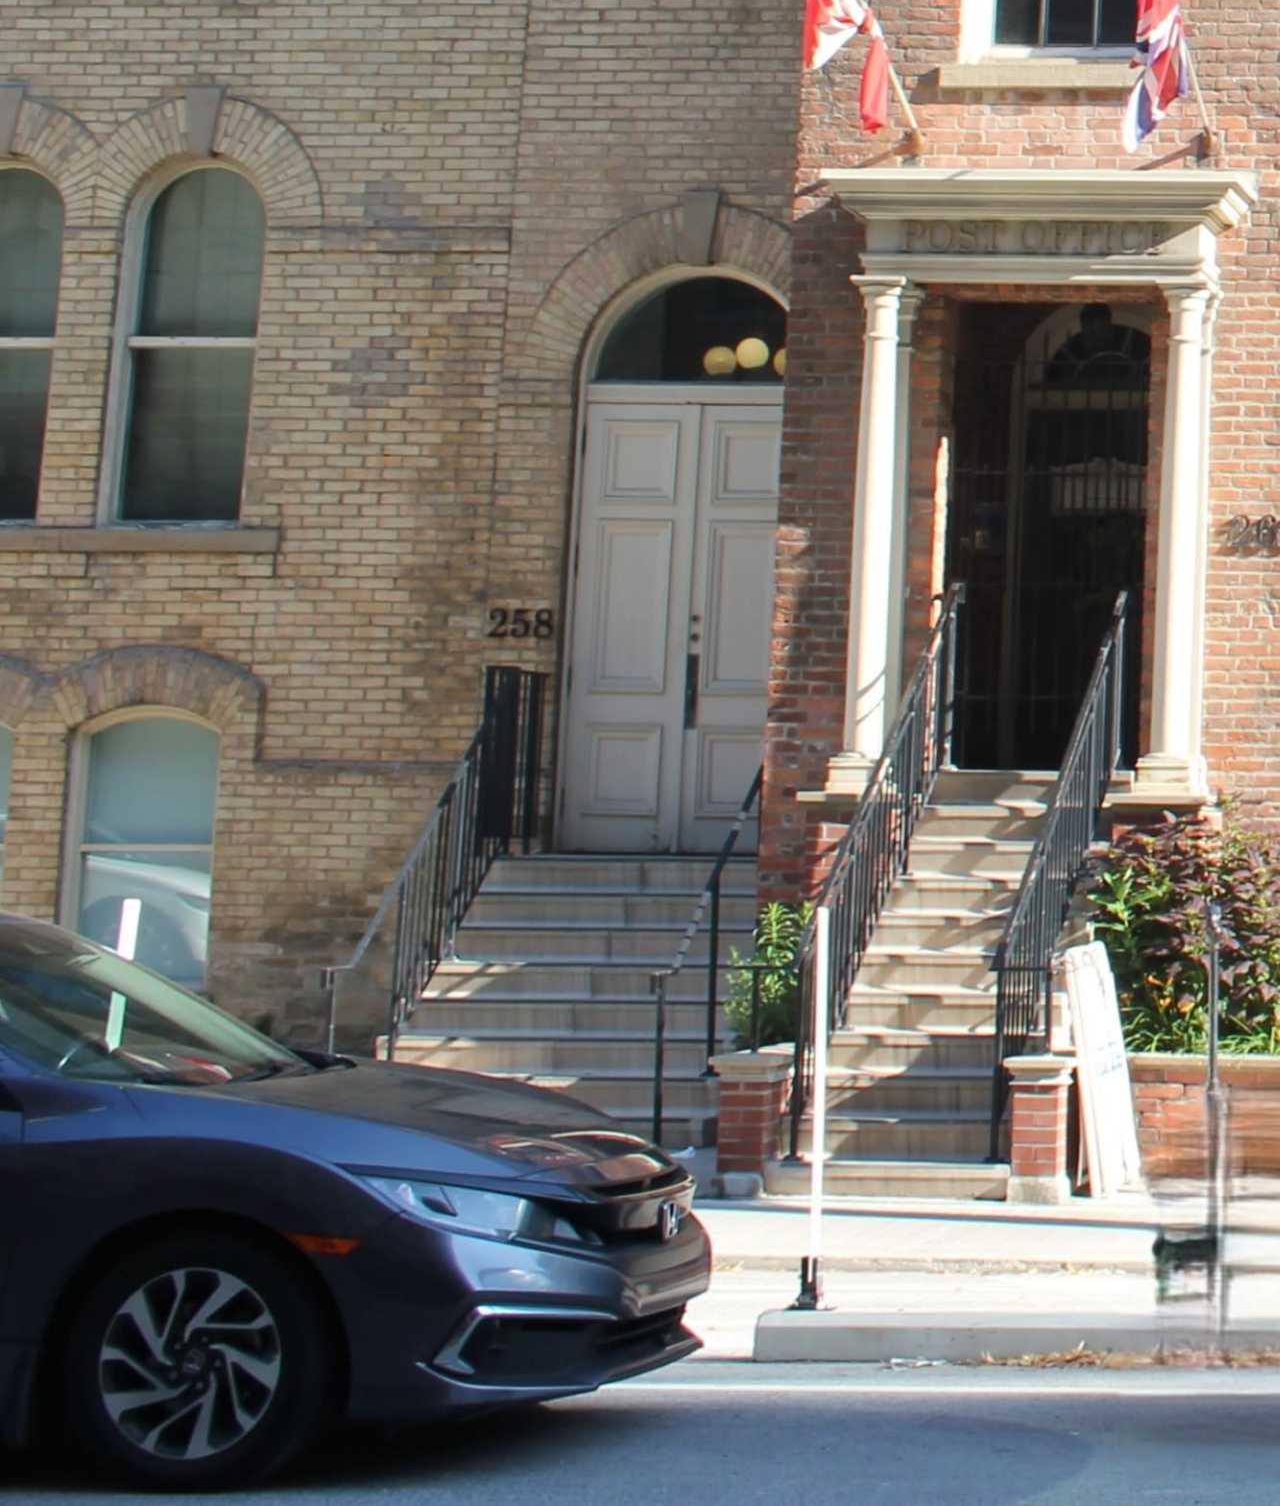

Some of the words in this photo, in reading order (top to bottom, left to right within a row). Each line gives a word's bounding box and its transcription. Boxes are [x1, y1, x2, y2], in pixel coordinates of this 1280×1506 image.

[903, 220, 1004, 252] POST
[1021, 221, 1168, 254] OFFICE
[487, 606, 554, 640] 258
